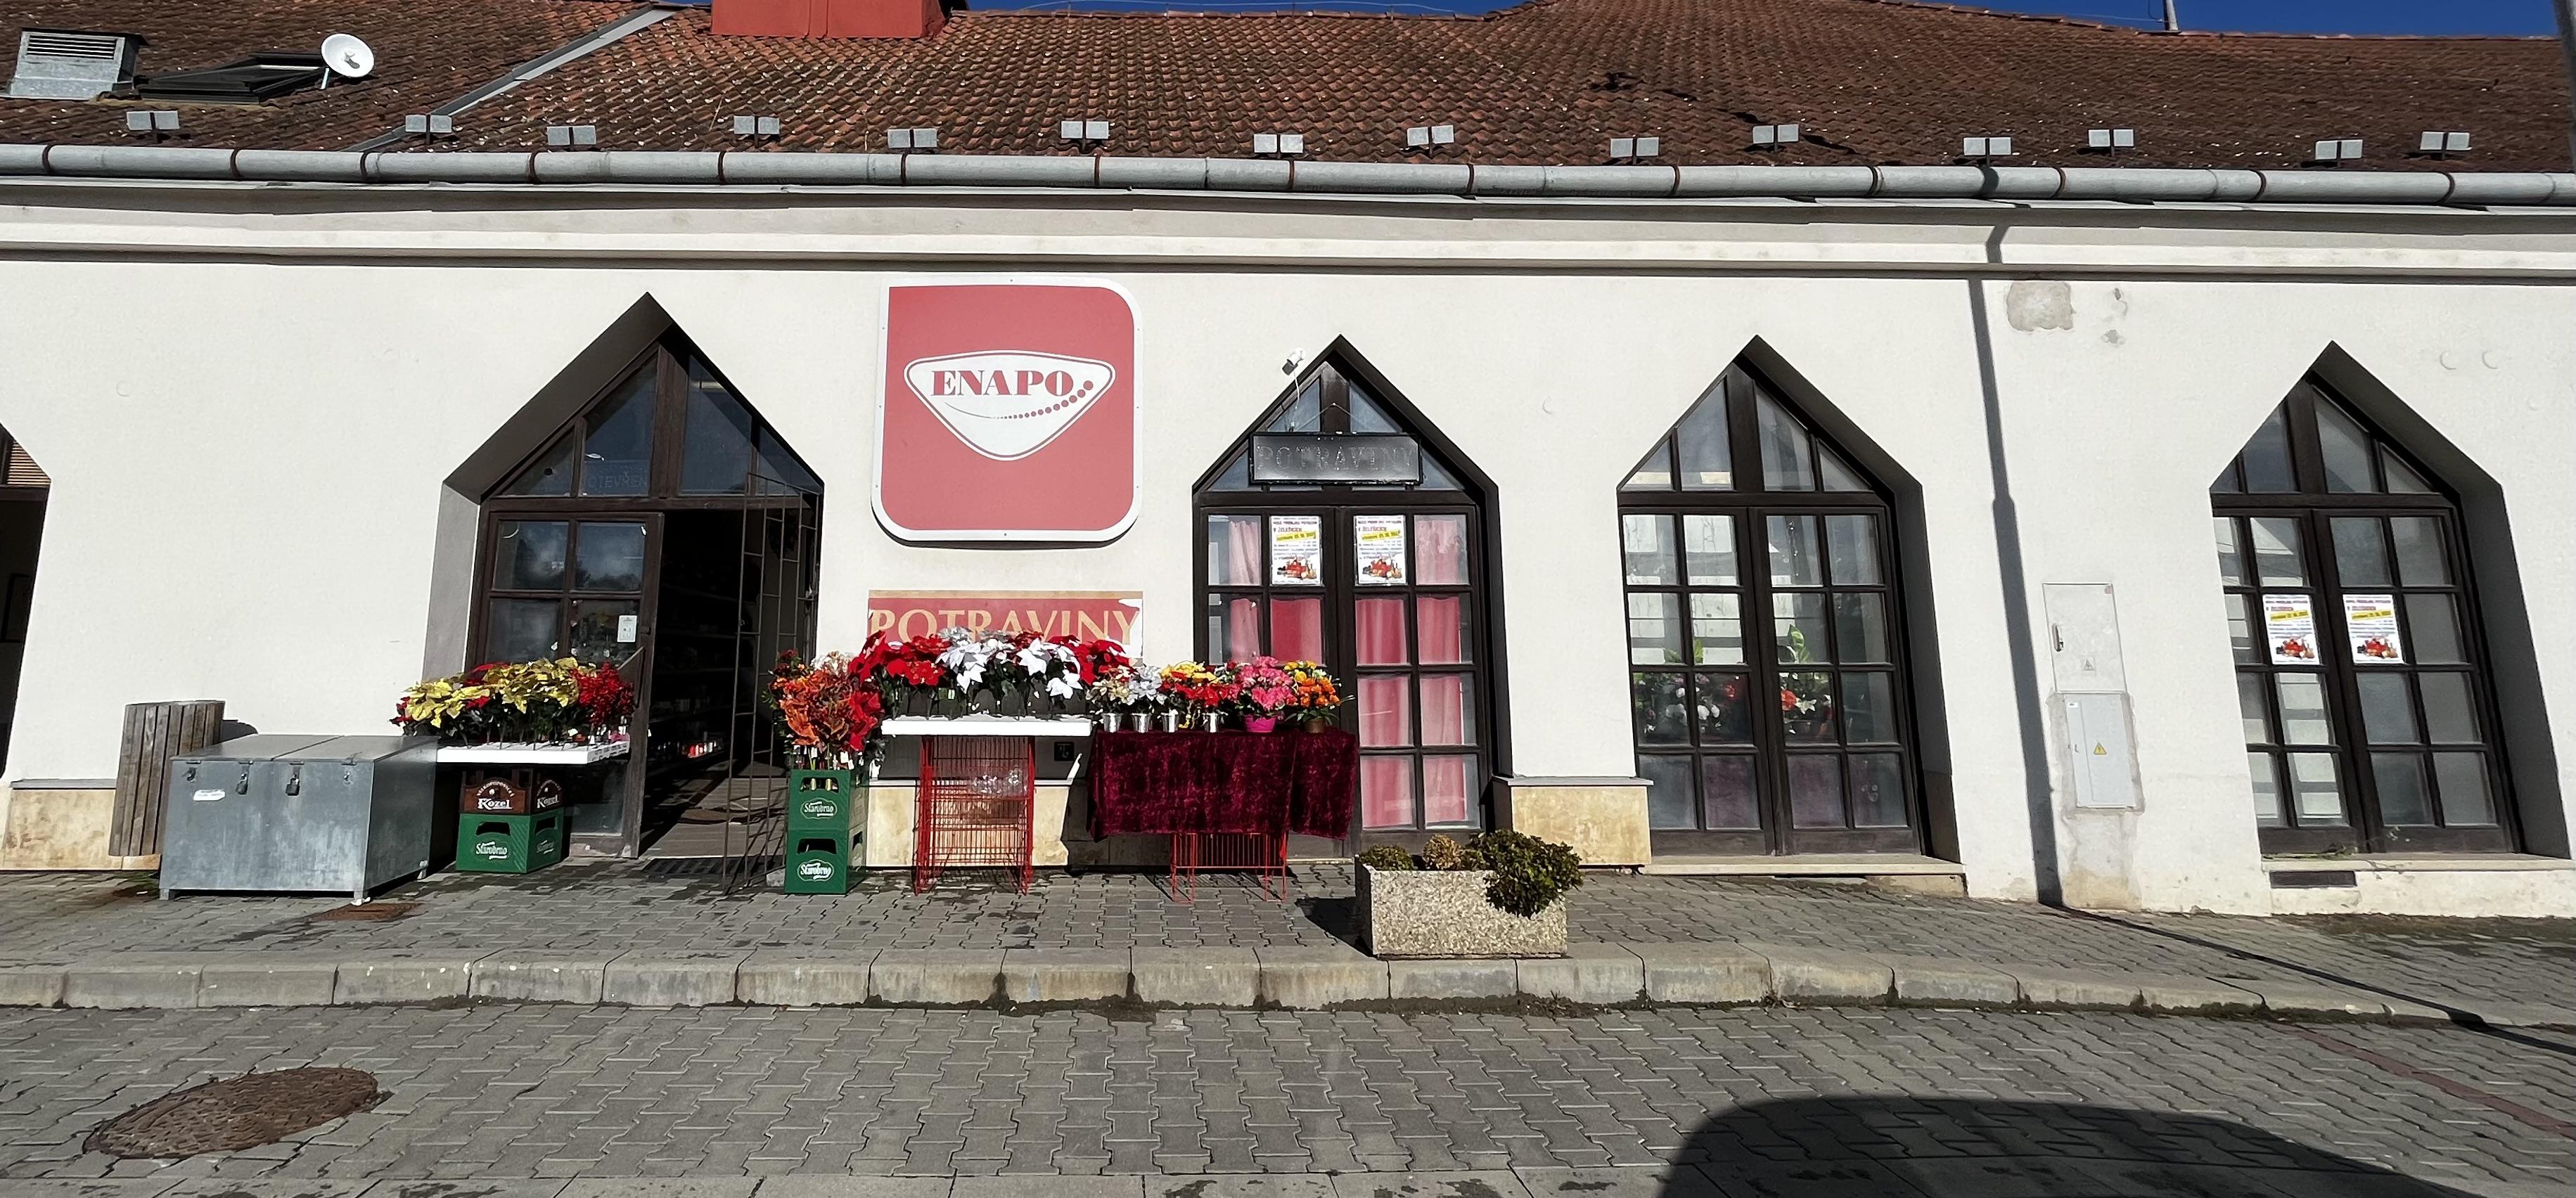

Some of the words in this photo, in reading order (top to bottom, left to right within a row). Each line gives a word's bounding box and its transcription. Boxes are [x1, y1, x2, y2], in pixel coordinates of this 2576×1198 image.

[930, 370, 1074, 397] ENAPO
[1256, 446, 1417, 470] POTRAVINY
[869, 609, 1140, 645] POTRAVINY
[478, 798, 513, 810] Kozel
